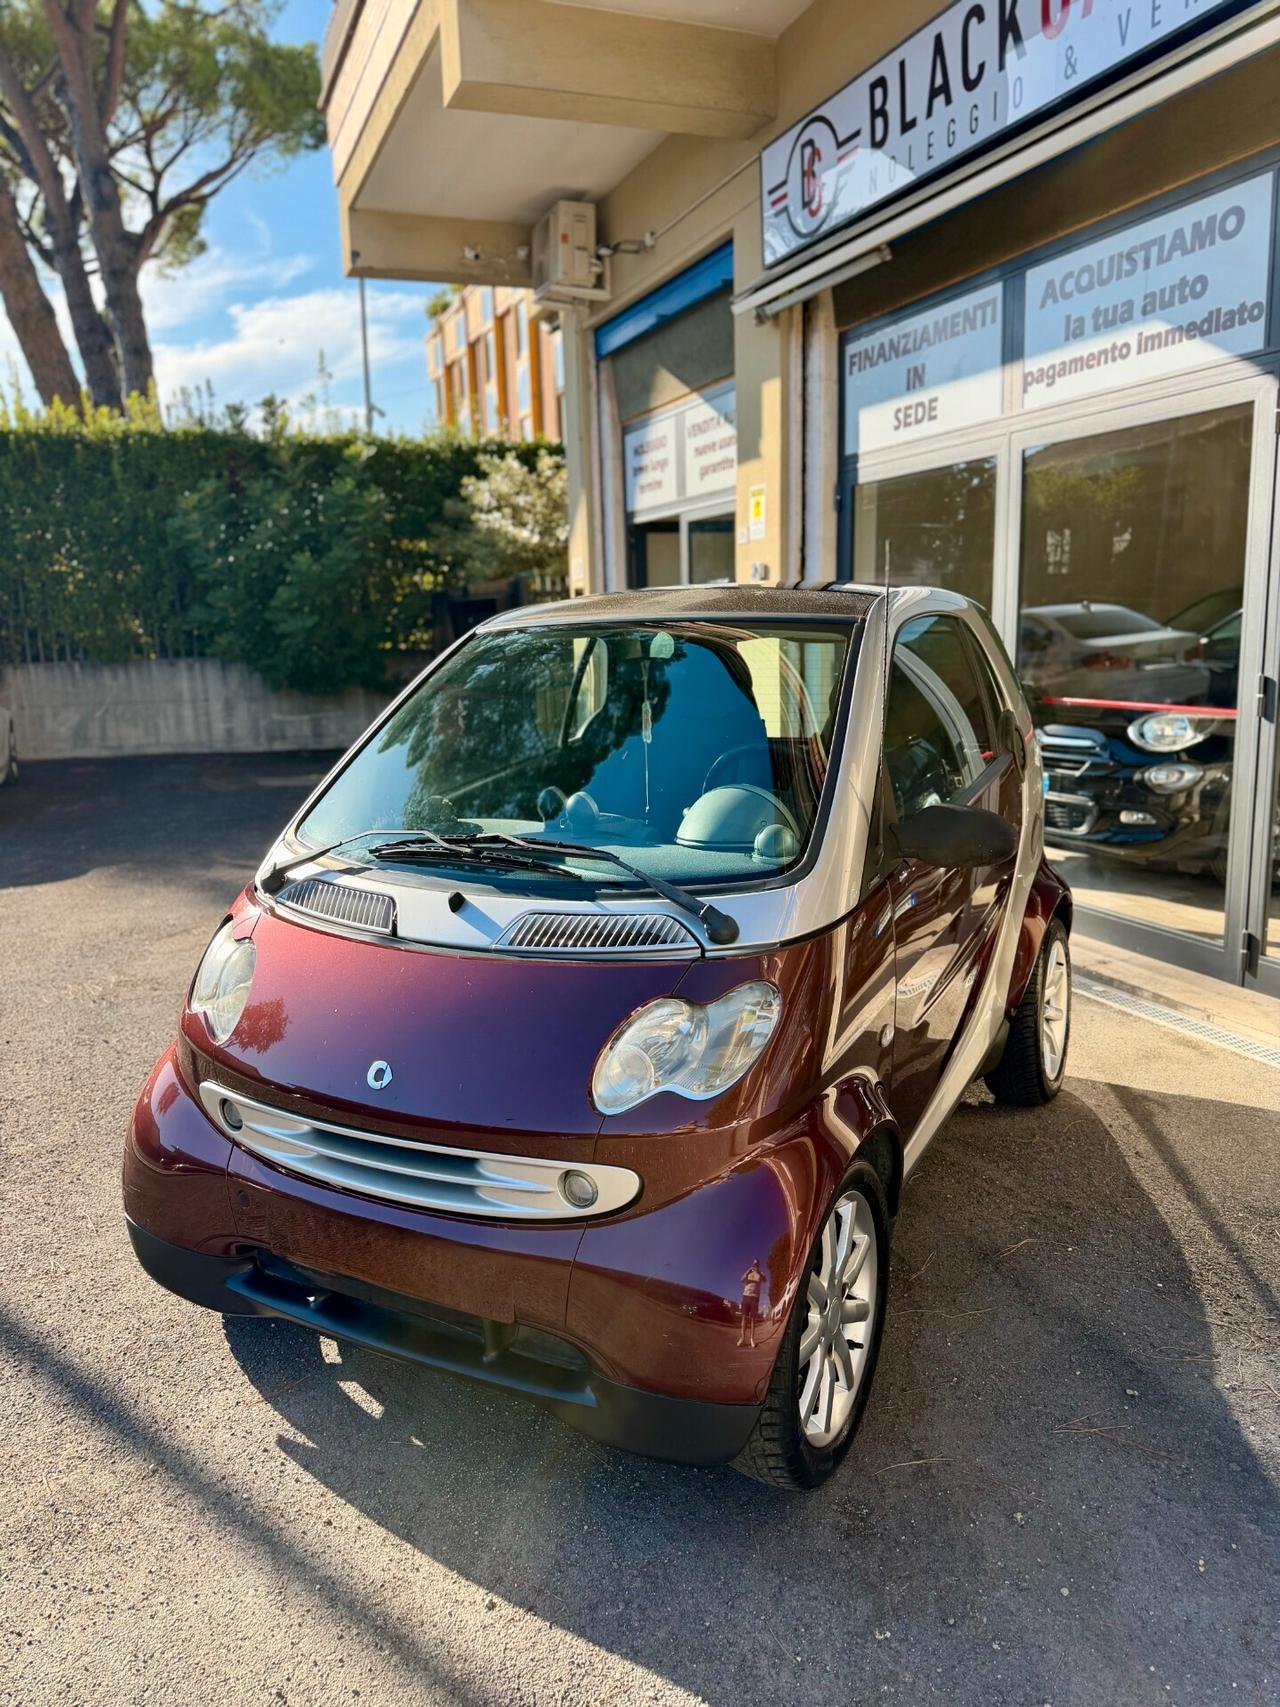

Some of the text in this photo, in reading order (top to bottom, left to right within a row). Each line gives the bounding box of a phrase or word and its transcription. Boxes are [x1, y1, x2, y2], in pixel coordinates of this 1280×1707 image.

[868, 76, 1023, 195] NOLEGGIO
[1064, 45, 1079, 80] &
[1038, 205, 1246, 309] ACQUISTIAMO
[848, 296, 999, 376] FINANZIAMENTI
[1023, 299, 1265, 394] pagamento immediato
[1064, 273, 1209, 342] la tua auto
[893, 396, 939, 432] SEDE
[906, 362, 926, 391] IN
